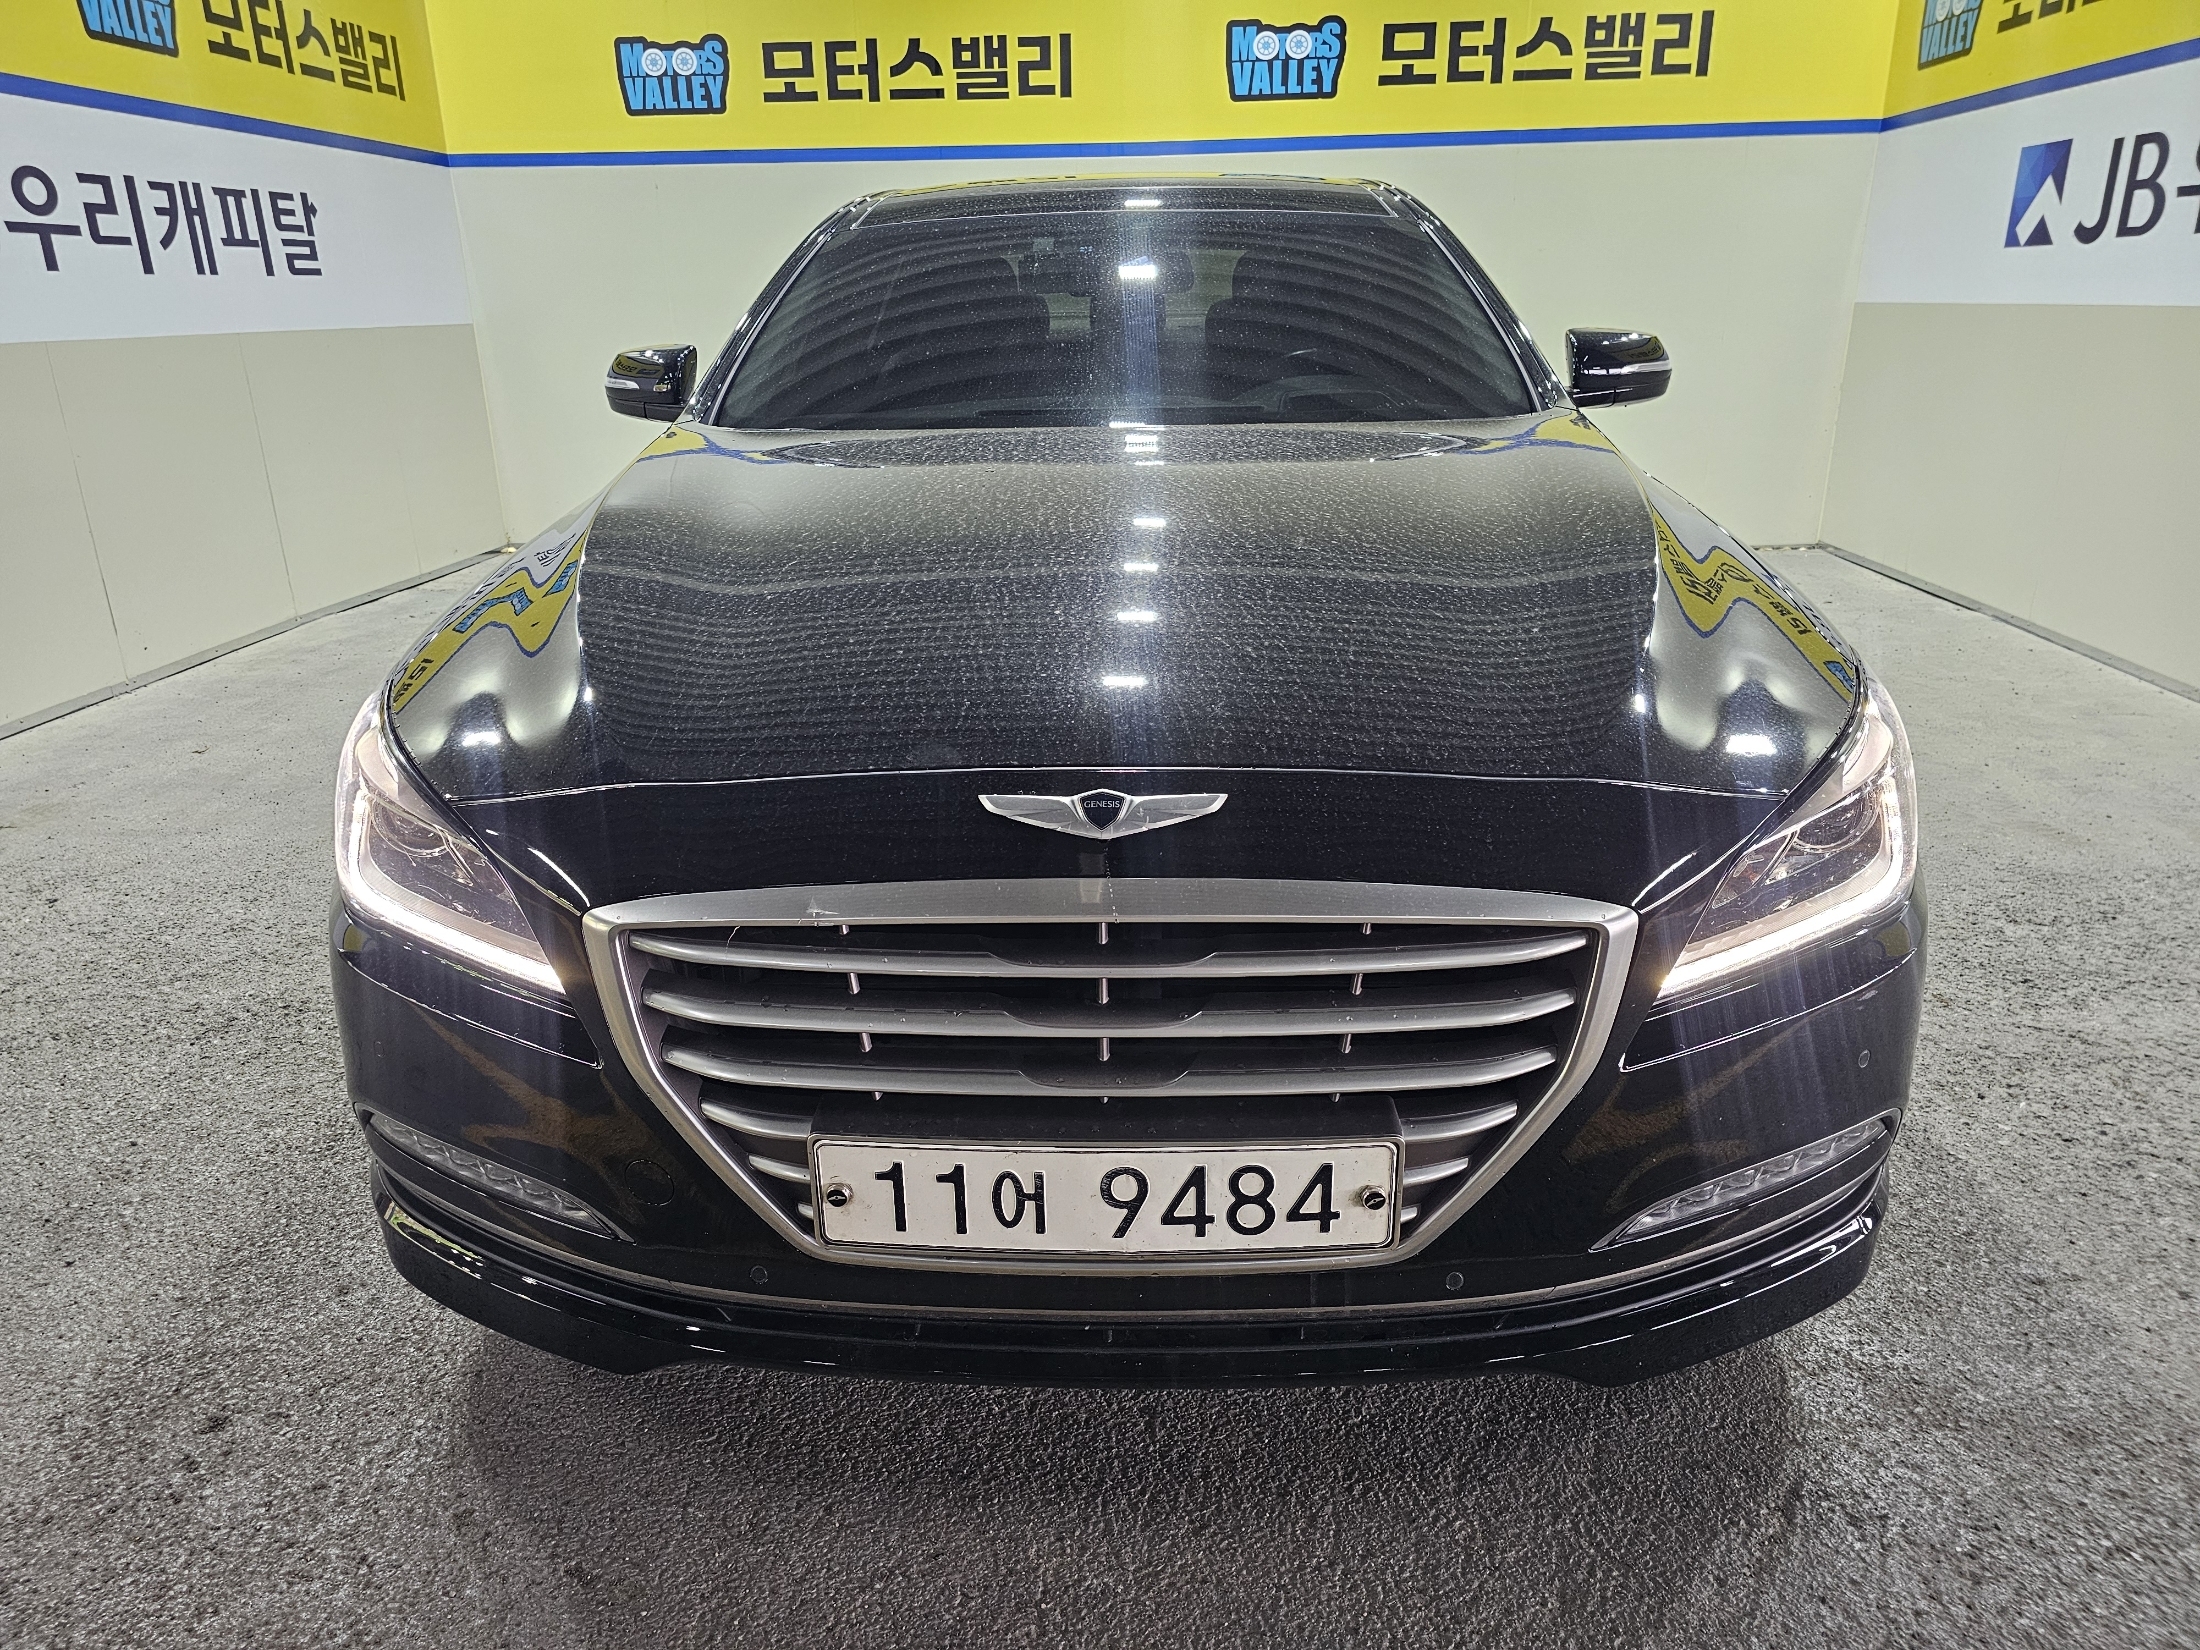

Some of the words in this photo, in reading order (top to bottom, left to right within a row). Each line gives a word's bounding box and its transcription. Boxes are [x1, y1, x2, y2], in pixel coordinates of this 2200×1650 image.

[81, 0, 174, 49] VALLEY
[202, 0, 406, 101] 모터스밸리
[1232, 22, 1341, 60] MOTORS
[1378, 10, 1715, 86] 모터스밸리
[1920, 9, 1980, 64] VALLEY
[620, 41, 724, 76] MOTORS
[762, 33, 1072, 102] 모터스밸리
[1232, 59, 1338, 95] VALLEY
[624, 76, 723, 110] VALLEY
[4, 165, 322, 276] 우리캐피탈
[1083, 800, 1121, 808] GENESIS
[875, 1161, 1046, 1234] 11어
[1100, 1163, 1341, 1239] 9484
